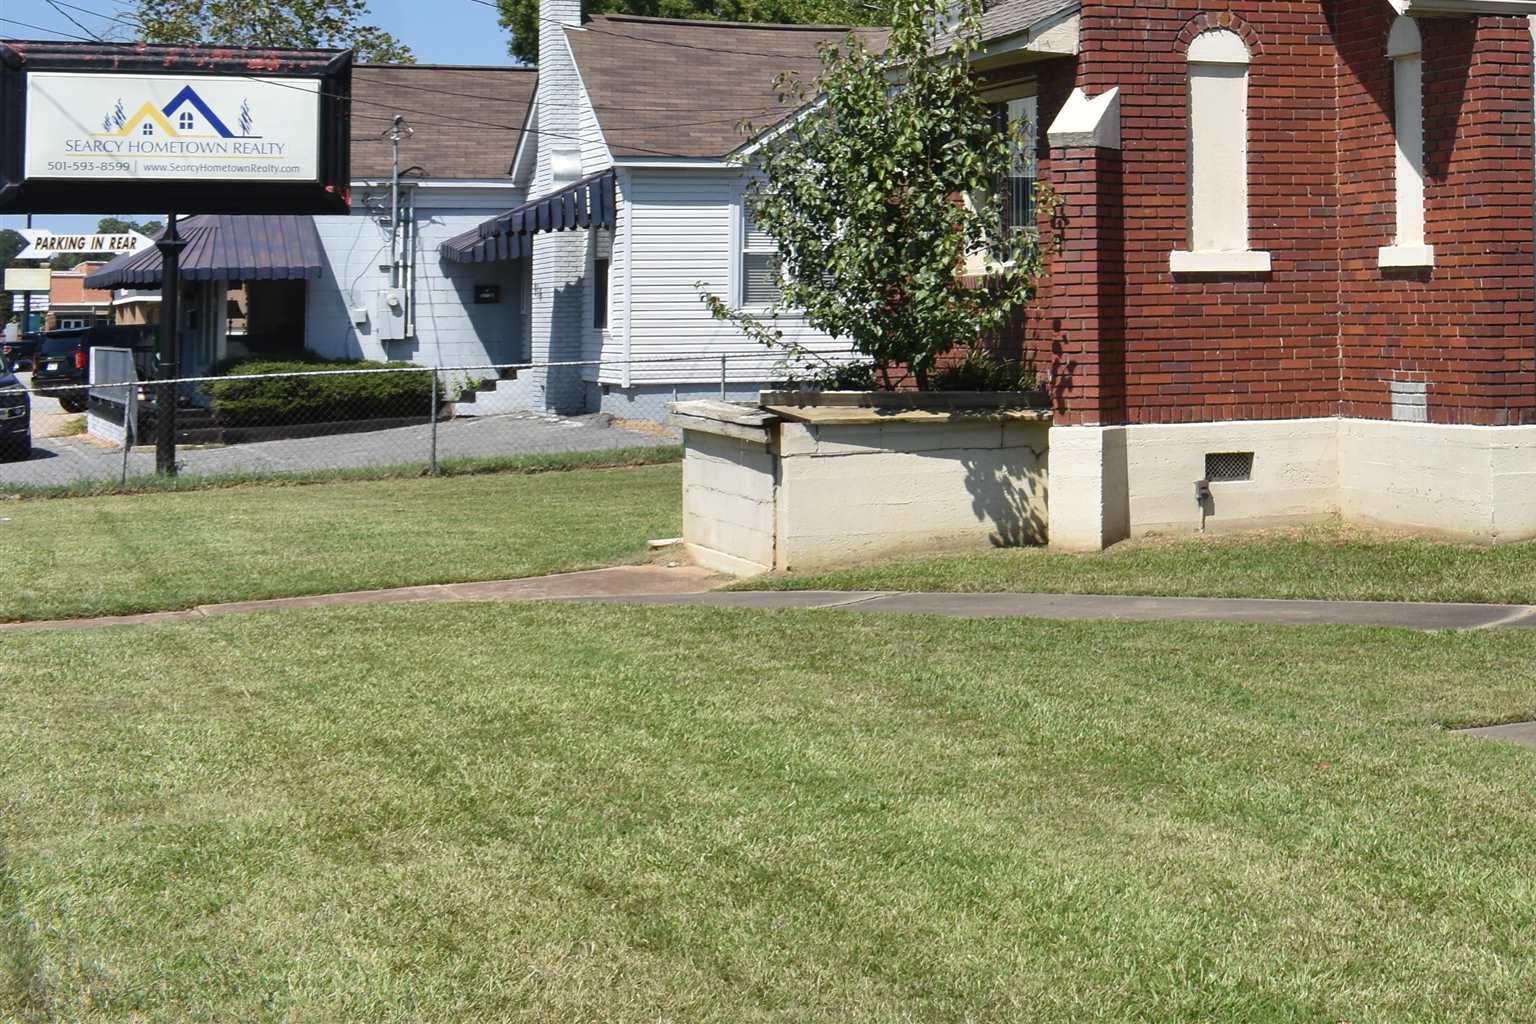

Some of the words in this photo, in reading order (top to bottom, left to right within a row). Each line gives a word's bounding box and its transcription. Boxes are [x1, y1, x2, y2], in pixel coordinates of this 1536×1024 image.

[64, 138, 125, 153] SEARCY
[129, 140, 228, 154] HOMETOWN
[233, 142, 287, 155] REALTY
[47, 161, 130, 172] 501-593-8599
[143, 162, 300, 175] www.SearcyHometownRealty.com
[34, 237, 86, 251] PARKING
[90, 237, 105, 250] IN
[109, 236, 137, 250] REAR
